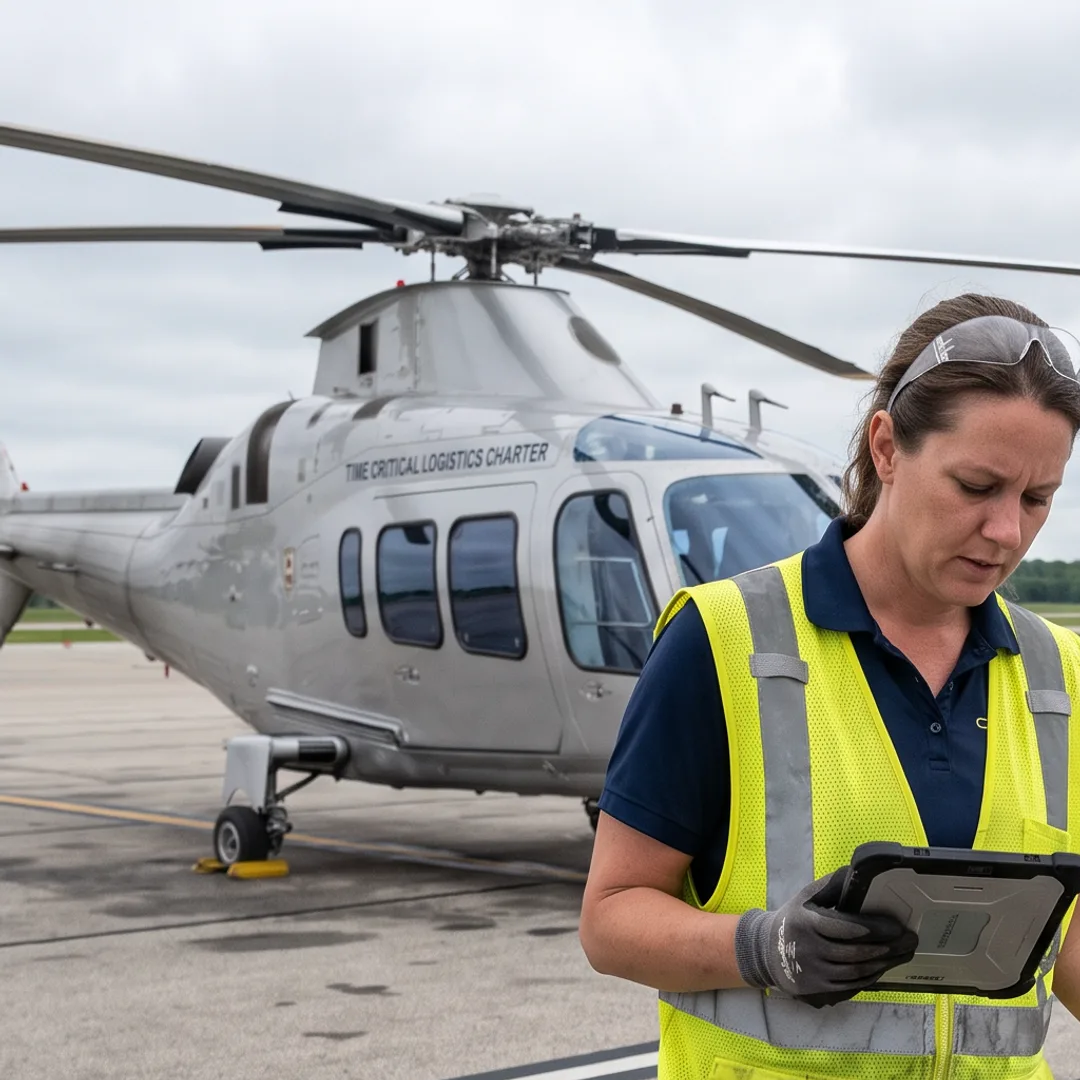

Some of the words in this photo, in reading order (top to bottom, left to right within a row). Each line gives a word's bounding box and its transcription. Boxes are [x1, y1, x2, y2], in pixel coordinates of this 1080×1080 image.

[346, 462, 369, 482] TIME
[370, 456, 419, 480] CRITICAL
[421, 448, 484, 473] LOGISTICS
[486, 442, 549, 466] CHARTER
